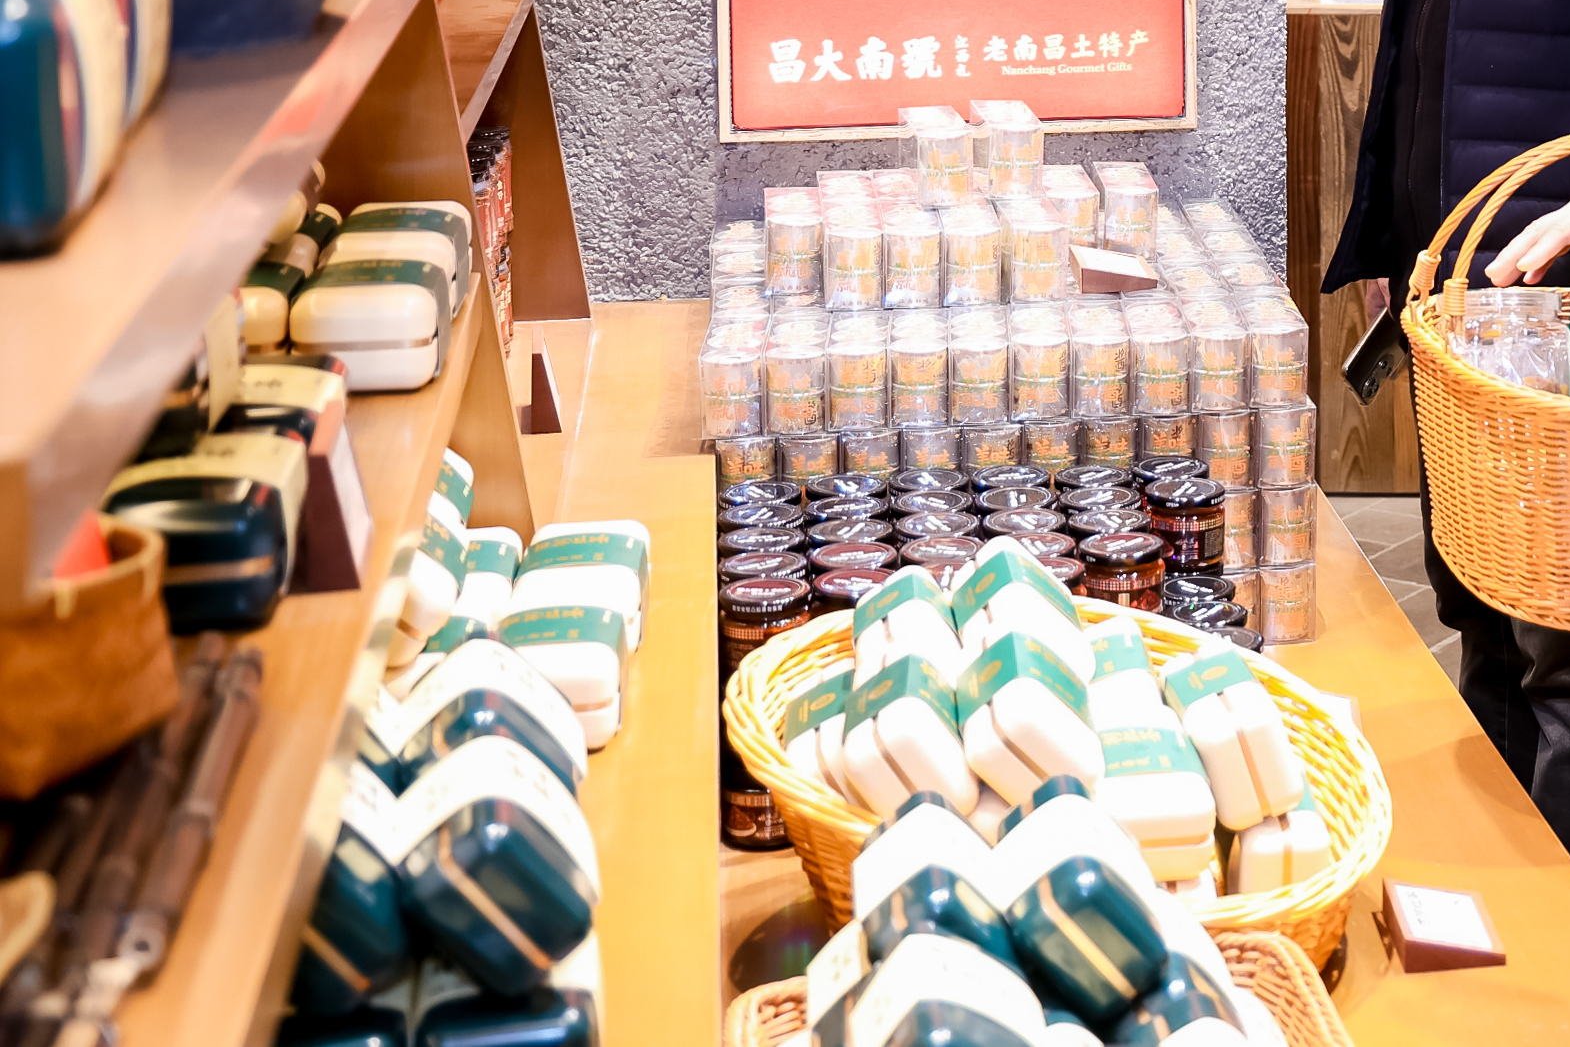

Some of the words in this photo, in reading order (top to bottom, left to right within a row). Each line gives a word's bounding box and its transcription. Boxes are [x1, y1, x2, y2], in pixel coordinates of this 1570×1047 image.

[983, 30, 1150, 61] 老南昌土特产
[1001, 65, 1056, 76] Nanchang
[1057, 63, 1106, 74] Gourmet
[1107, 61, 1133, 71] Gifts
